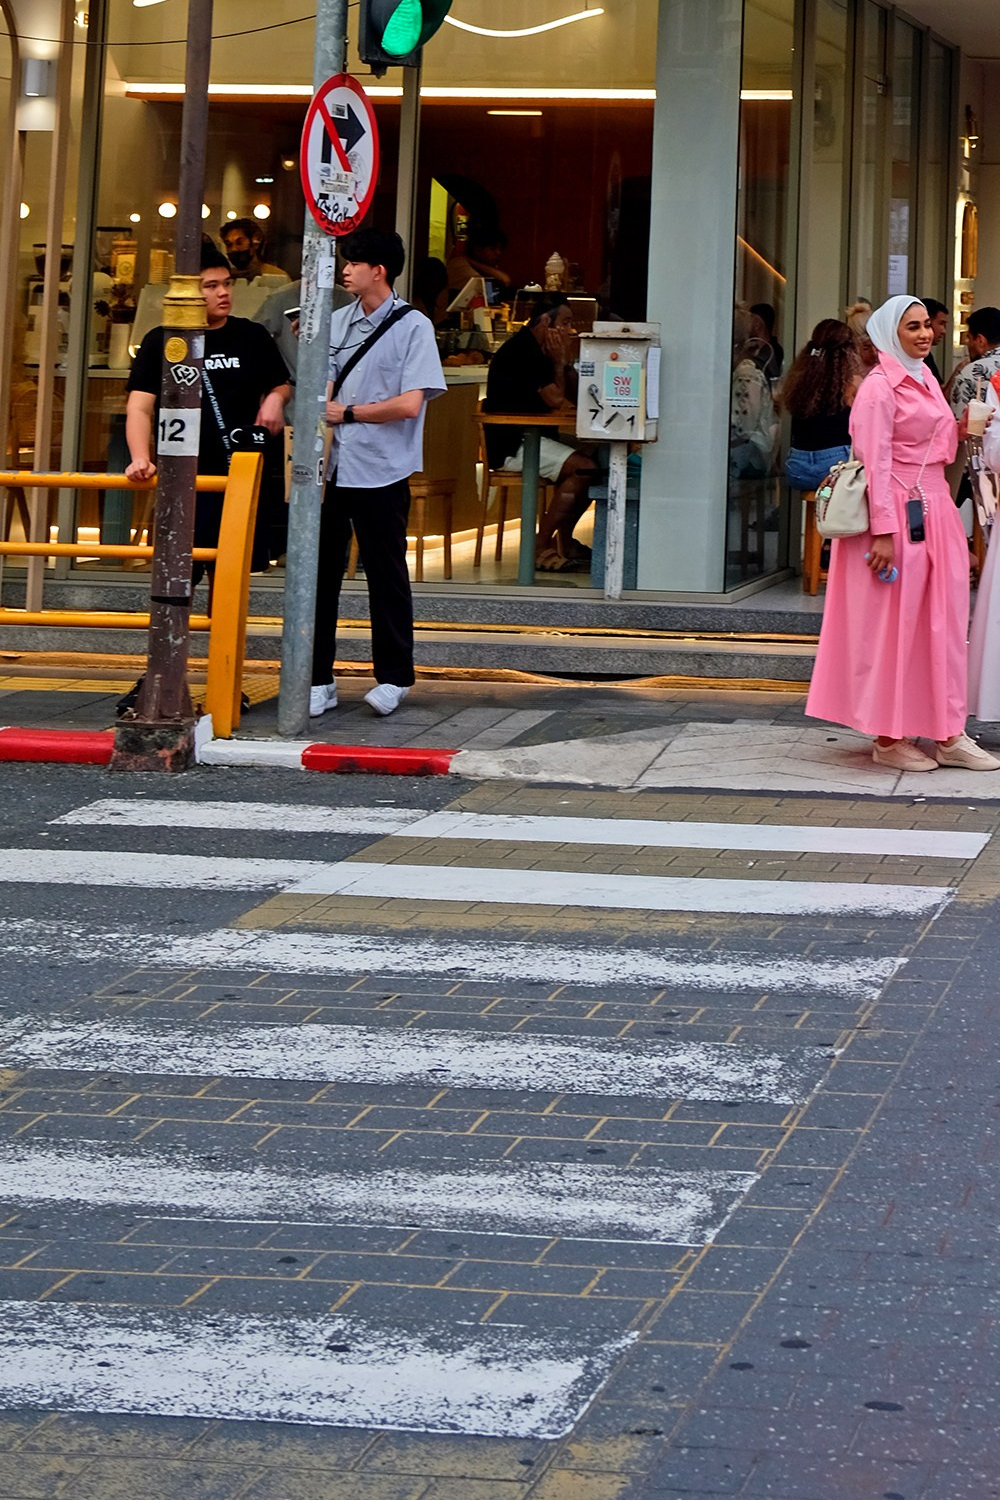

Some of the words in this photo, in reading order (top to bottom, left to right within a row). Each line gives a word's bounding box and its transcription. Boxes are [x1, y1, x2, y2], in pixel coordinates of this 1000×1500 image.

[613, 376, 632, 386] SW
[614, 386, 631, 396] 169
[208, 394, 226, 430] ARMOUR
[160, 418, 186, 442] 12
